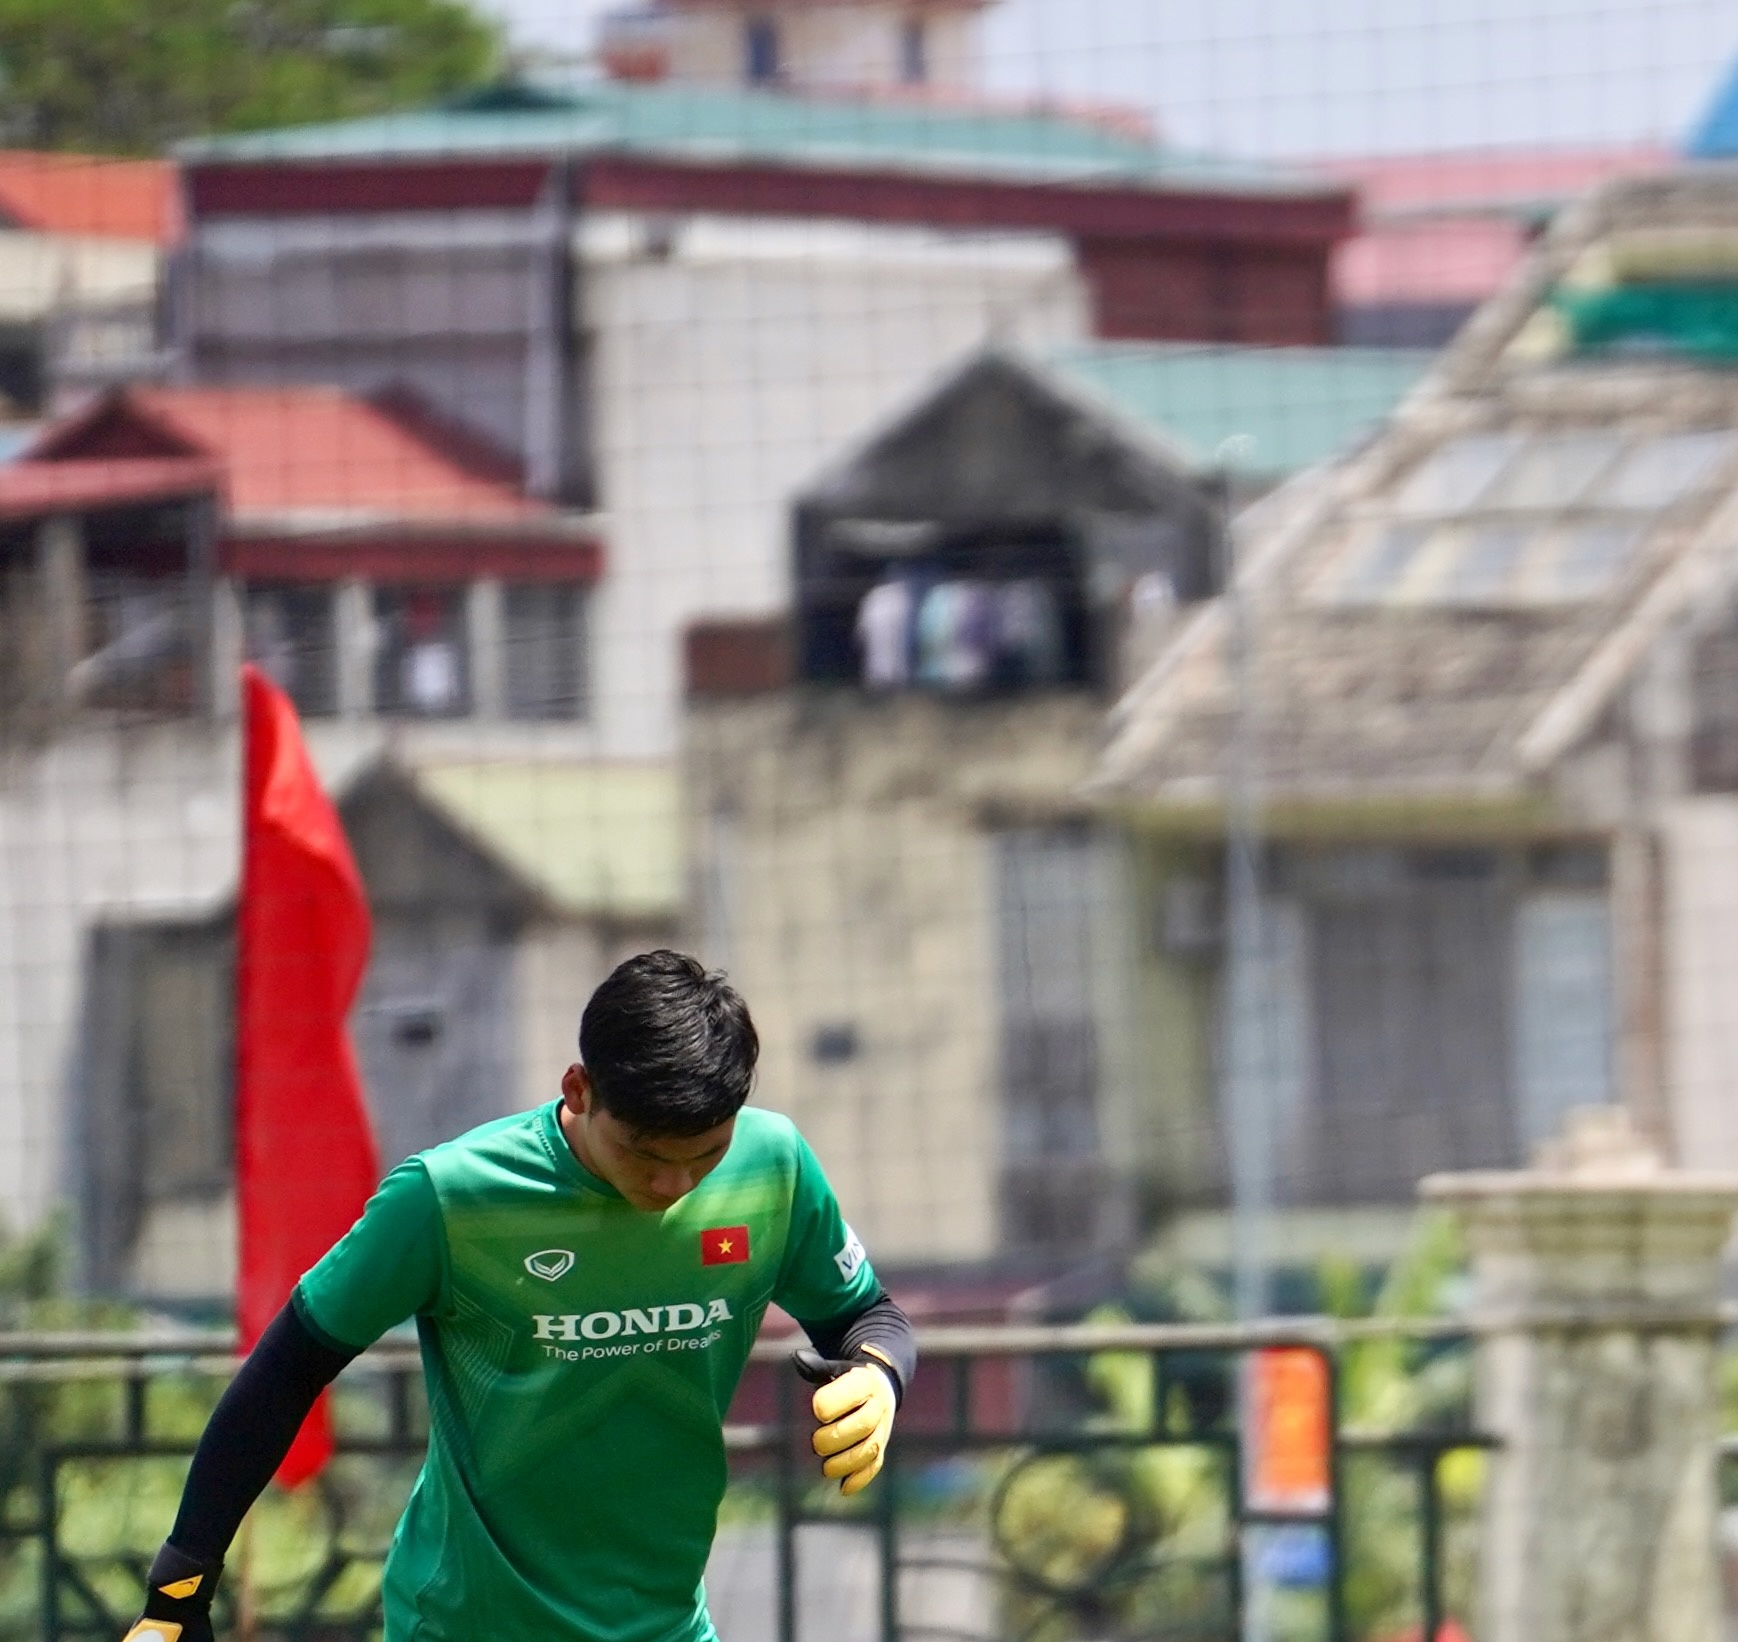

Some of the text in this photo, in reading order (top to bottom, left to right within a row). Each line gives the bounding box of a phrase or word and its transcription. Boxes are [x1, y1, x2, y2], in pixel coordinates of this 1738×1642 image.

[532, 1298, 734, 1341] HONDA
[541, 1344, 579, 1361] The
[581, 1343, 640, 1360] Power
[643, 1338, 663, 1353] of
